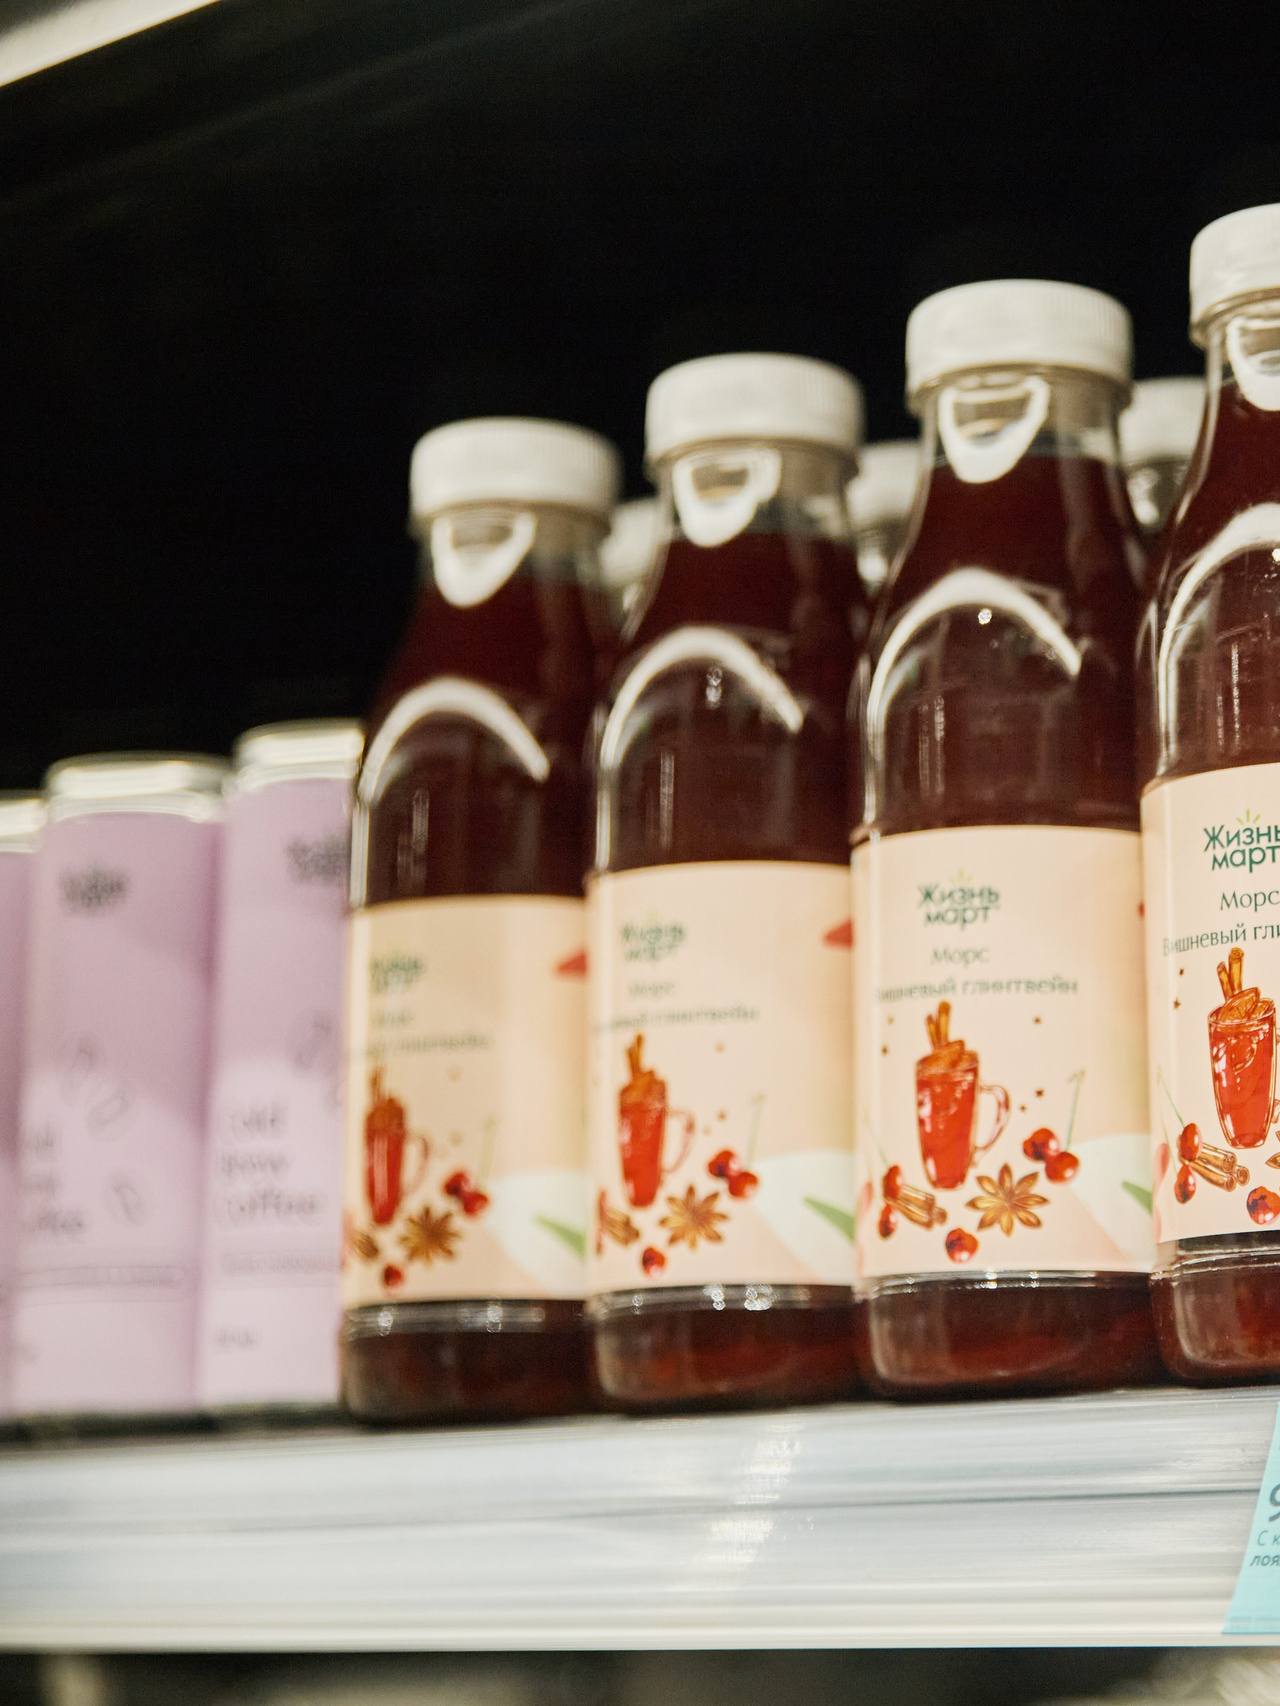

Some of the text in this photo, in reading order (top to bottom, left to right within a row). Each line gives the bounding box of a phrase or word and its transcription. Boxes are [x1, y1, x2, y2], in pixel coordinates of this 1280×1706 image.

[917, 884, 1001, 909] Жизнь
[1220, 890, 1280, 912] Морс
[1163, 923, 1247, 957] Вишневый
[1256, 1529, 1269, 1547] С
